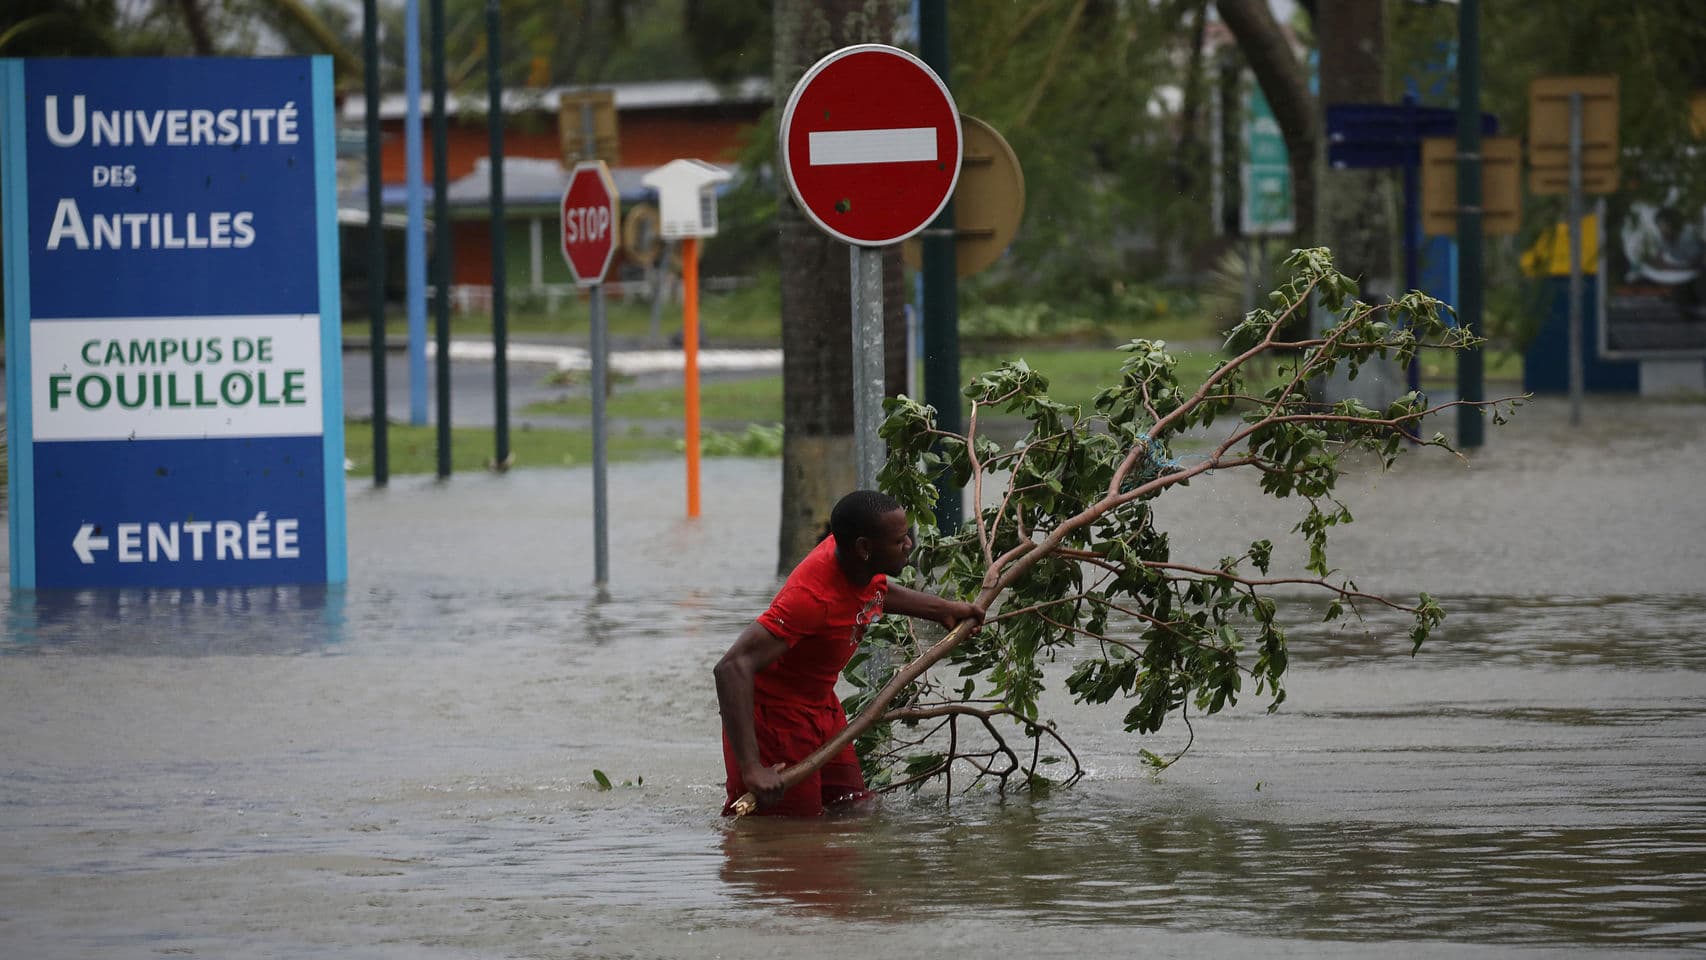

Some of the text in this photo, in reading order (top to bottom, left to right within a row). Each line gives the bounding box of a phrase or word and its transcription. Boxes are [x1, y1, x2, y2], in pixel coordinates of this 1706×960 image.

[45, 95, 299, 147] UNIVERSITÉ
[92, 165, 137, 187] DES
[46, 198, 256, 250] ANTILLES
[567, 205, 610, 244] STOP
[81, 336, 274, 366] CAMPUS DE
[49, 369, 307, 410] FOUILLOLE
[117, 511, 300, 562] ENTRÉE
